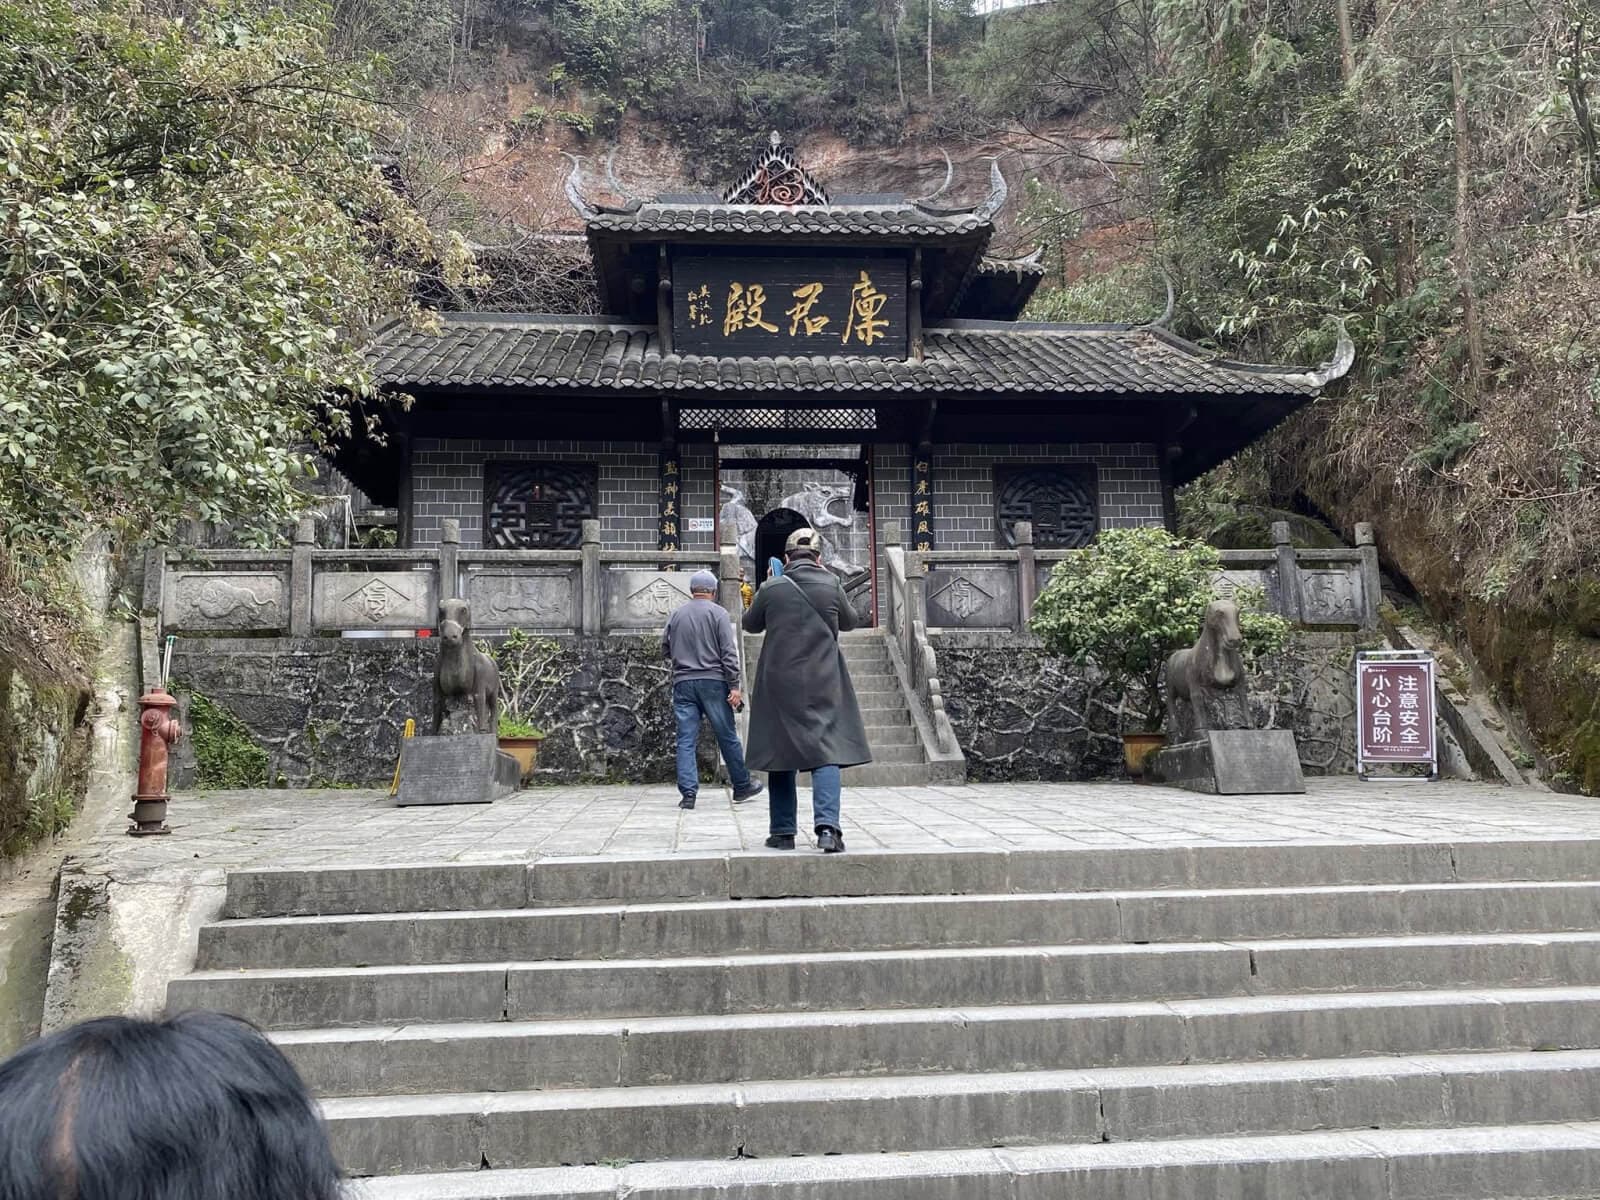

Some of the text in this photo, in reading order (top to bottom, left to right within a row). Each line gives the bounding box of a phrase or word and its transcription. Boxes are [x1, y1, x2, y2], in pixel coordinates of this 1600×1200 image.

[1371, 674, 1393, 744] 小心台阶
[1398, 675, 1421, 744] 注意安全
